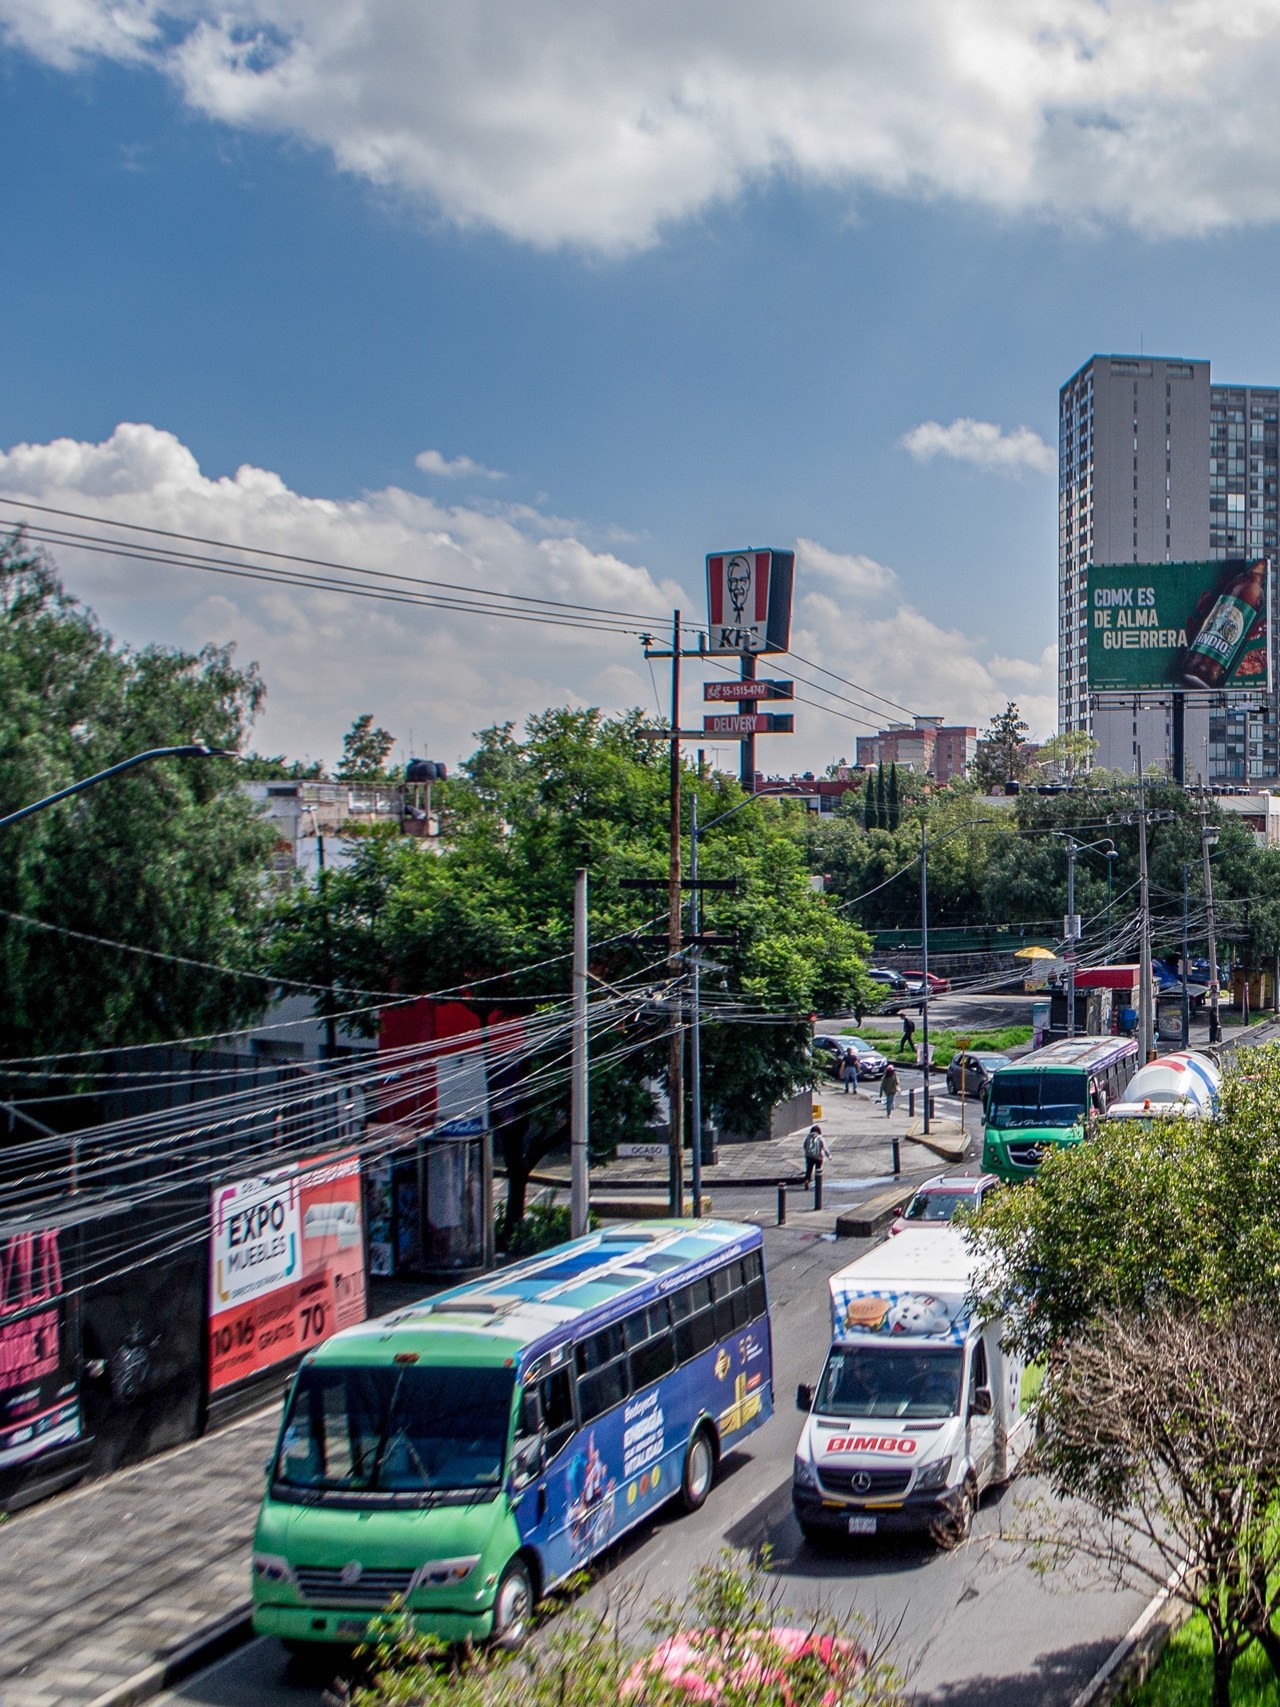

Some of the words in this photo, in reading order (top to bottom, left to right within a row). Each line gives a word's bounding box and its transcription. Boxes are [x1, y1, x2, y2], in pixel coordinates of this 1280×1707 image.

[1094, 588, 1133, 607] CDMX
[1138, 587, 1155, 606] ES
[1094, 610, 1112, 628] DE
[1117, 609, 1159, 627] ALMA
[1103, 629, 1189, 649] GUERRERA
[1197, 632, 1229, 654] INDIO
[714, 716, 758, 731] DELIVERY
[228, 1200, 284, 1249] EXPO
[227, 1234, 287, 1275] MUEBLES
[826, 1437, 918, 1454] BIMBO
